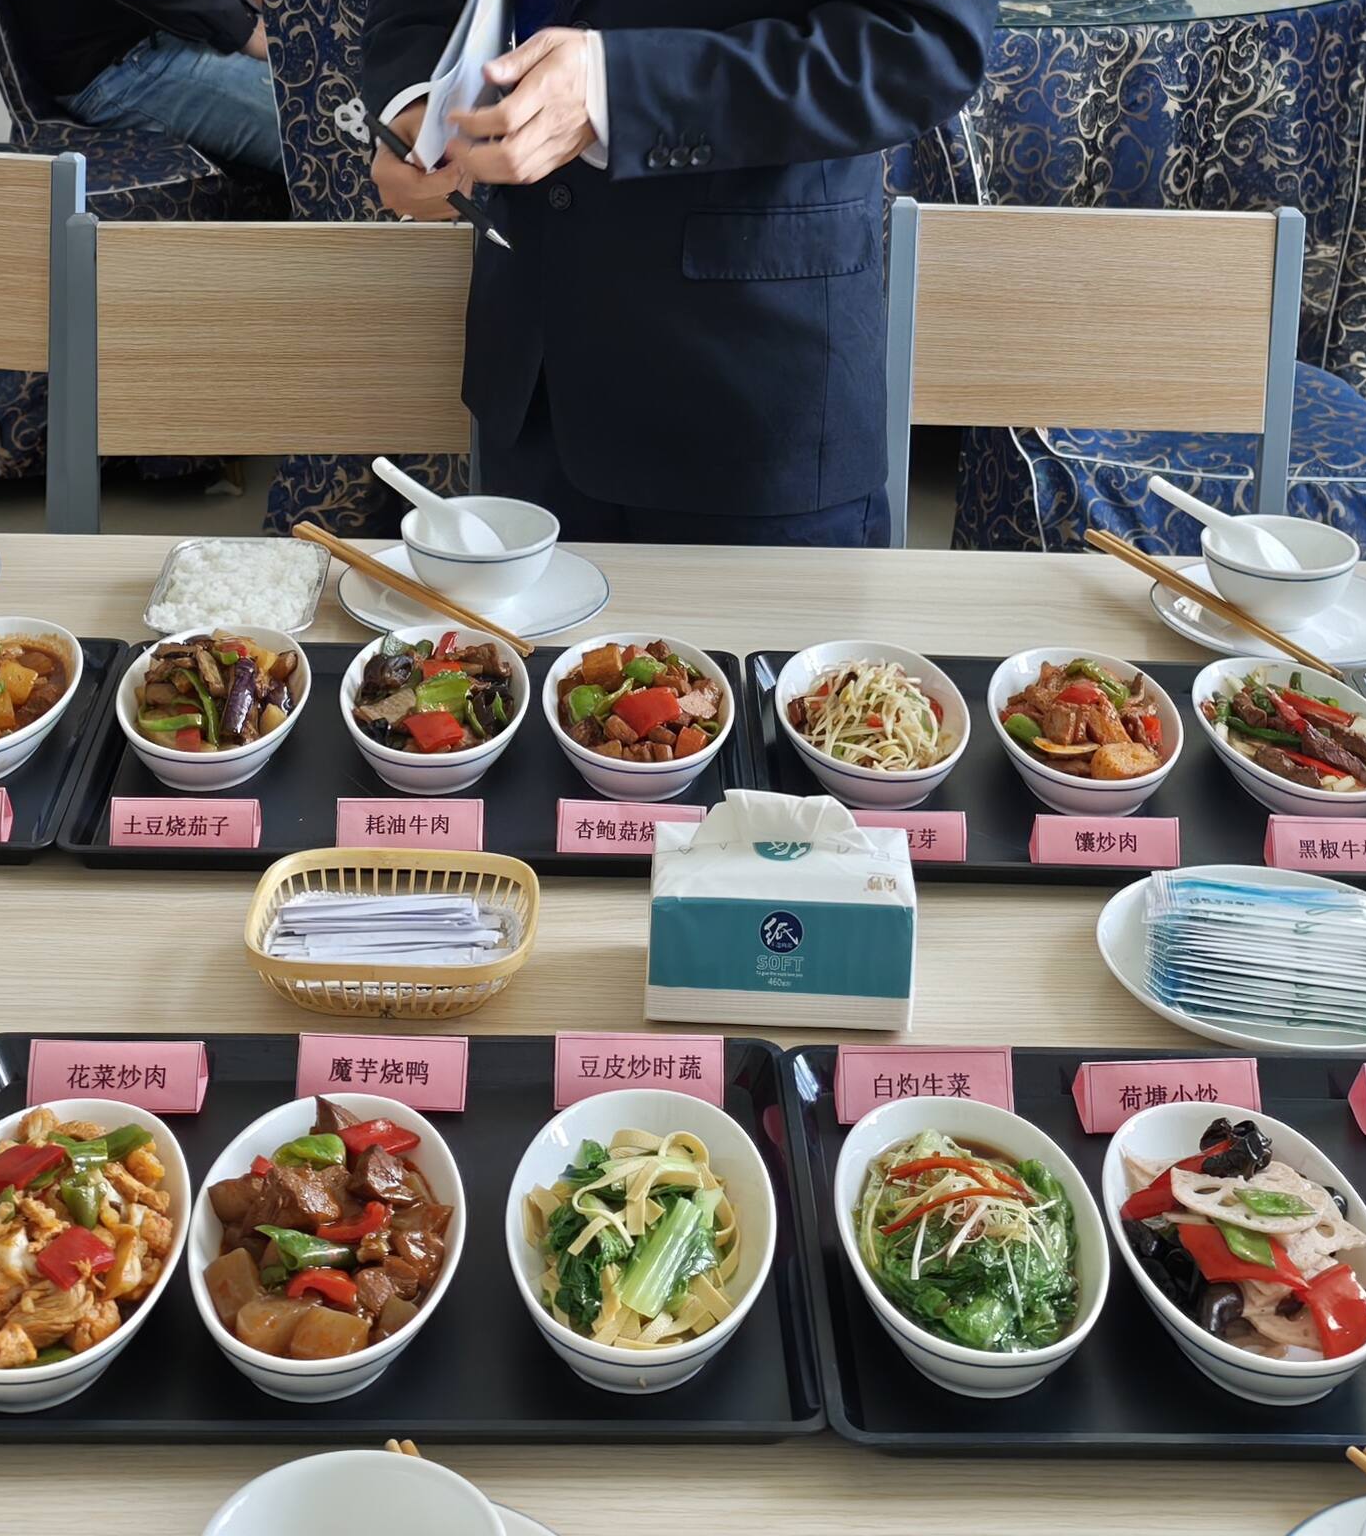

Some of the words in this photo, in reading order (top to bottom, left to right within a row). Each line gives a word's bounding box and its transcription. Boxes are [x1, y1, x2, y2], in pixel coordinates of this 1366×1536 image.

[122, 815, 230, 837] 土豆烧茄子
[365, 814, 450, 835] 耗油牛肉
[1075, 831, 1137, 853] 馕炒肉
[756, 954, 805, 972] SOFT
[66, 1064, 167, 1090] 花菜炒肉
[328, 1057, 430, 1085] 魔芋烧鸭
[577, 1054, 702, 1080] 豆皮炒时蔬
[873, 1072, 971, 1098] 白灼生菜
[1118, 1083, 1219, 1111] 荷塘小炒
